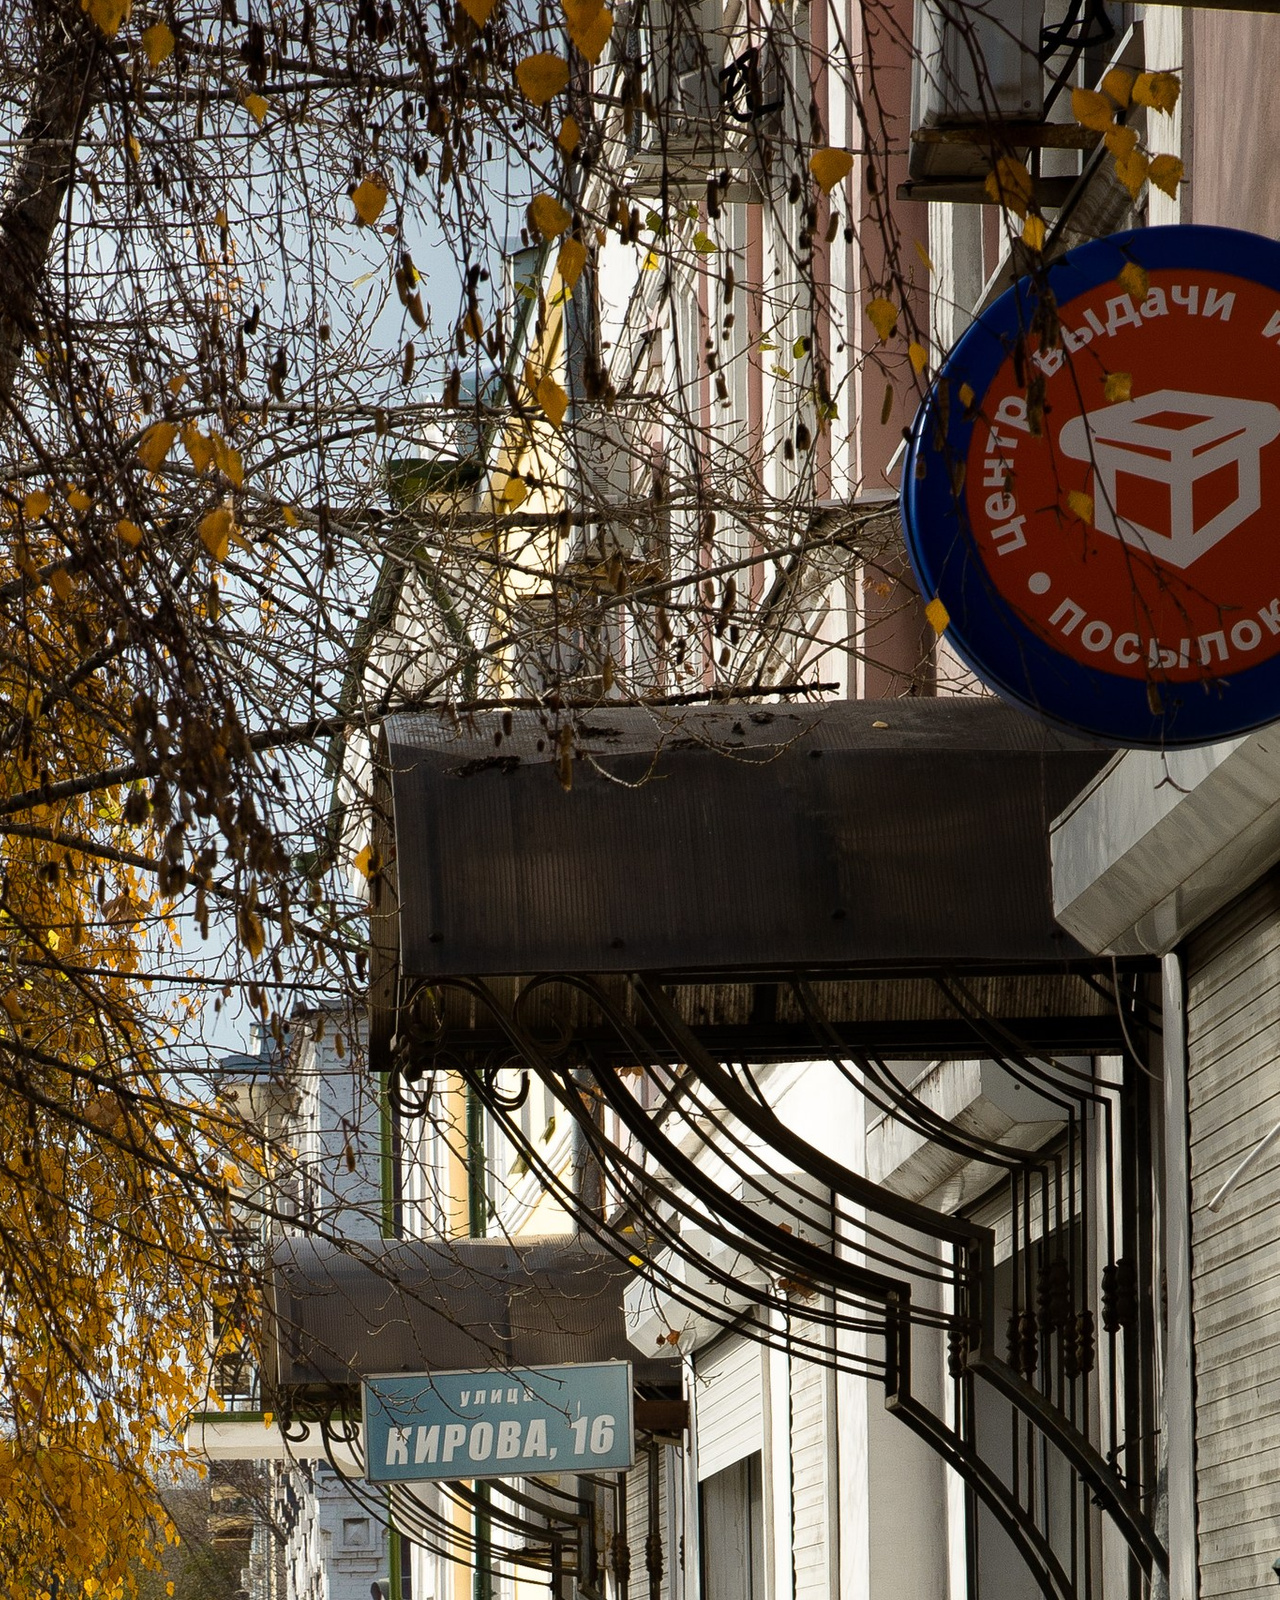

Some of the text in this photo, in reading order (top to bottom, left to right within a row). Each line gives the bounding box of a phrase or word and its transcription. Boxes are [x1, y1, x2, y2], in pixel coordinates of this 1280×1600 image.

[459, 1387, 536, 1408] улица
[385, 1414, 616, 1466] КИРОВА, 16
